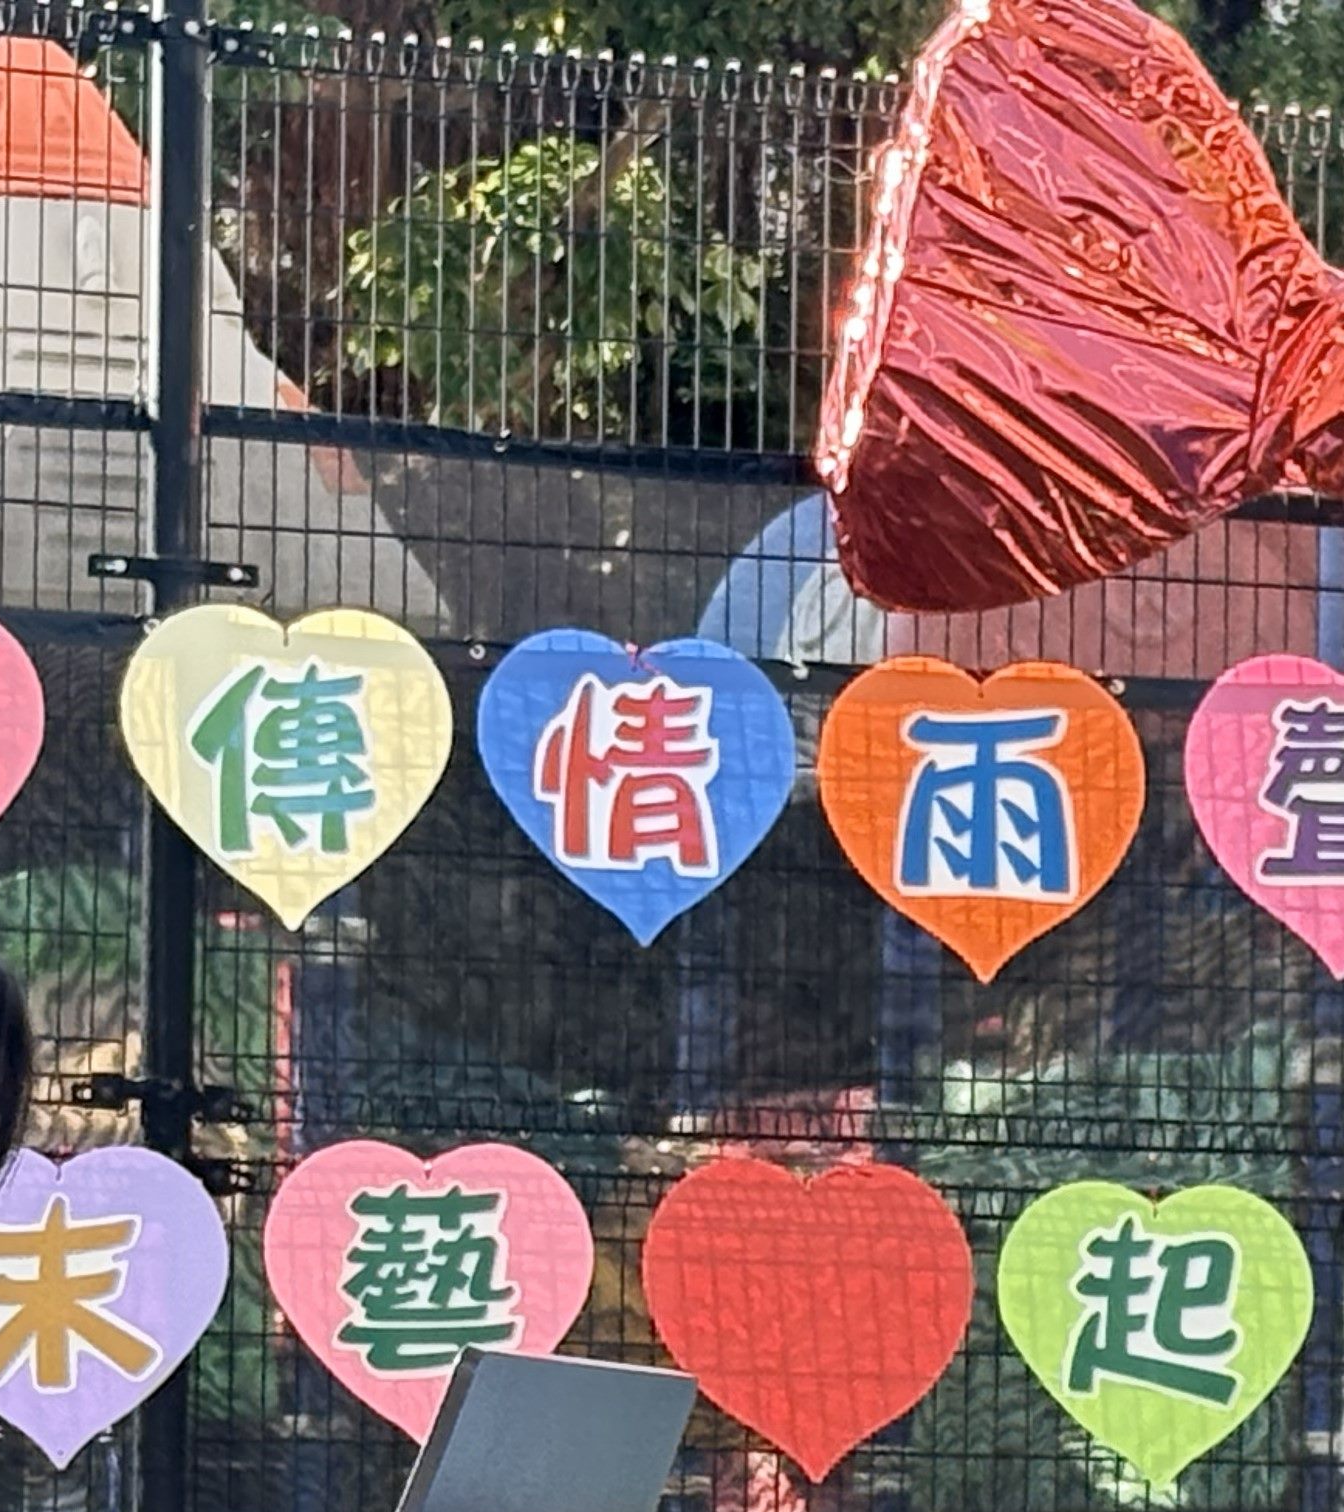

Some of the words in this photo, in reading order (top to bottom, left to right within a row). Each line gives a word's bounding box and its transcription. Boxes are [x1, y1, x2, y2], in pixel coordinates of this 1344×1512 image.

[191, 656, 375, 853] 傳
[540, 681, 712, 868] 情
[899, 713, 1070, 893] 雨
[336, 1184, 522, 1371] 藝
[1067, 1216, 1239, 1408] 起
